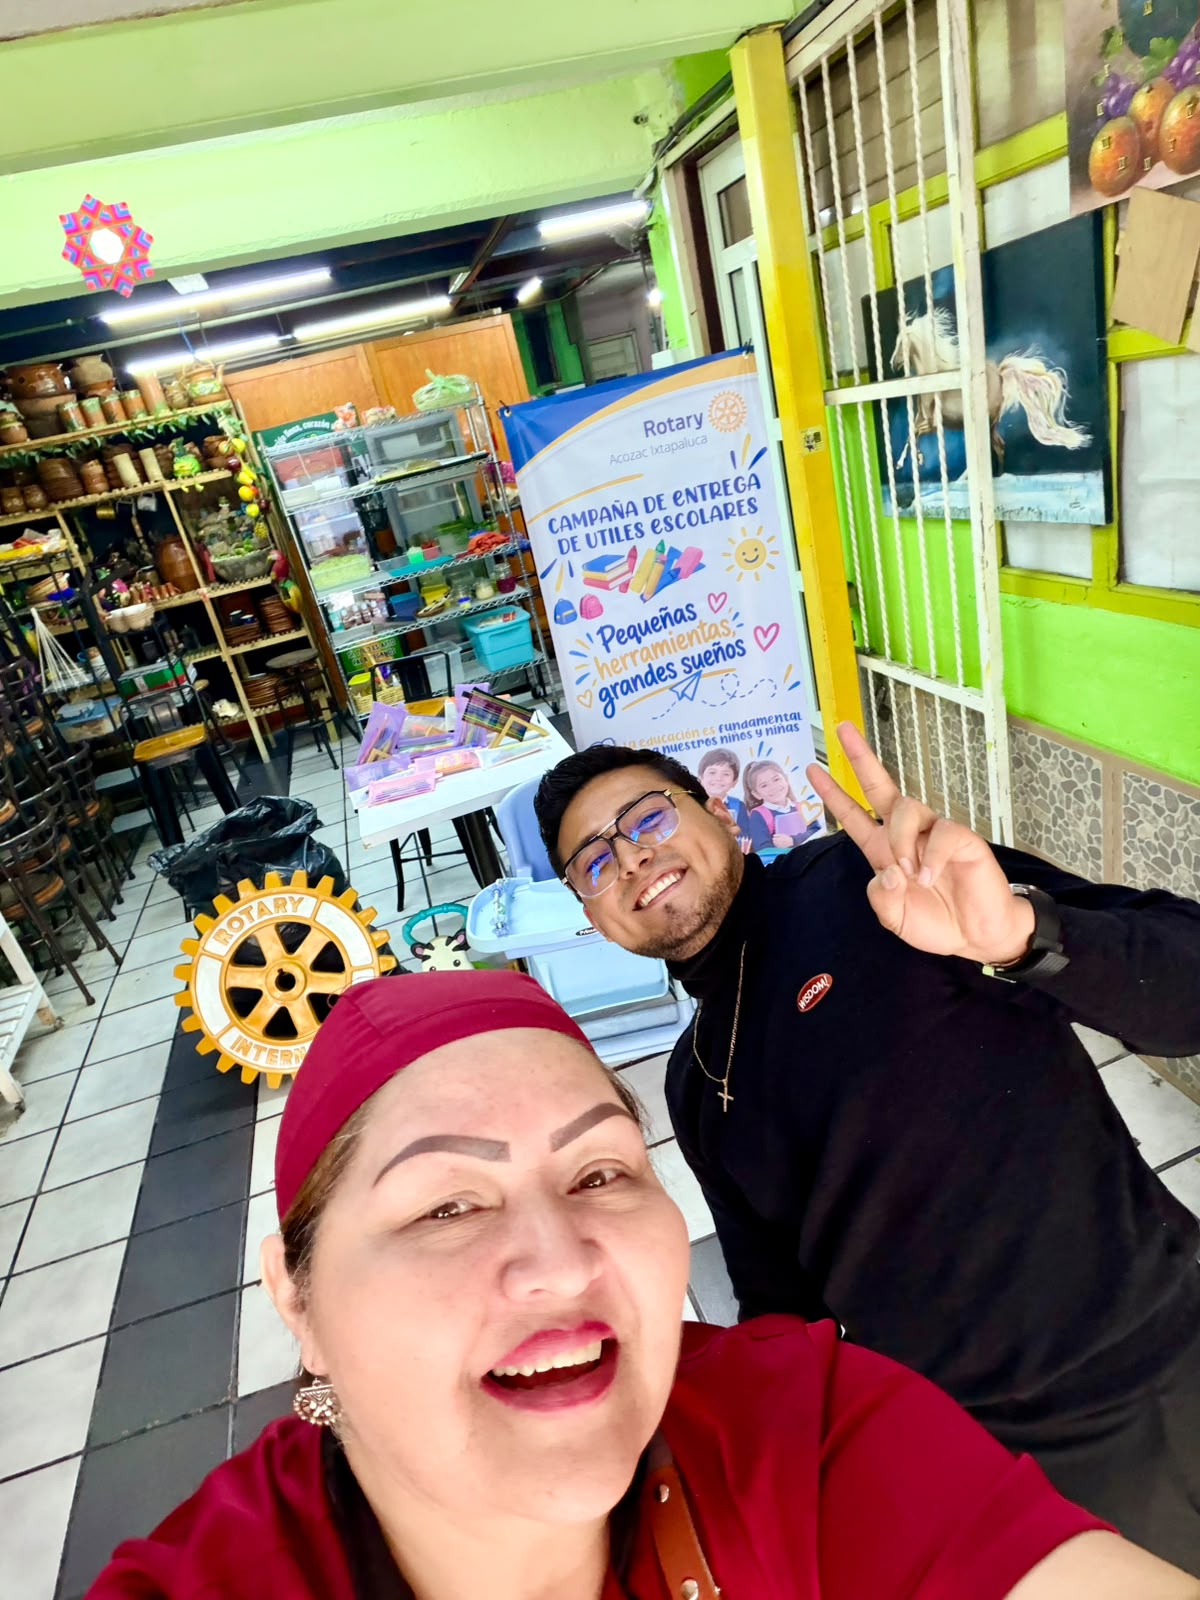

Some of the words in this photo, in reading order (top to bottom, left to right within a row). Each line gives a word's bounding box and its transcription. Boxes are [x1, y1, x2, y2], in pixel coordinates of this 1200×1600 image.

[643, 412, 704, 438] Rotary
[609, 448, 649, 465] Acozac
[651, 434, 708, 455] Ixtapaluca
[548, 499, 639, 534] CAMPAÑA
[643, 493, 667, 514] DE
[557, 535, 582, 555] DE
[585, 522, 645, 549] UTILES
[596, 603, 698, 653] Pequeñas
[594, 619, 736, 681] herramientas,
[598, 663, 678, 719] grandes
[681, 639, 747, 675] sueños
[639, 728, 700, 747] educación
[702, 727, 716, 738] es
[662, 737, 718, 754] nuestros
[720, 731, 753, 745] niños
[755, 729, 763, 738] y
[765, 722, 800, 736] niñas
[213, 896, 304, 946] ROTARY
[230, 1034, 307, 1066] INTERN
